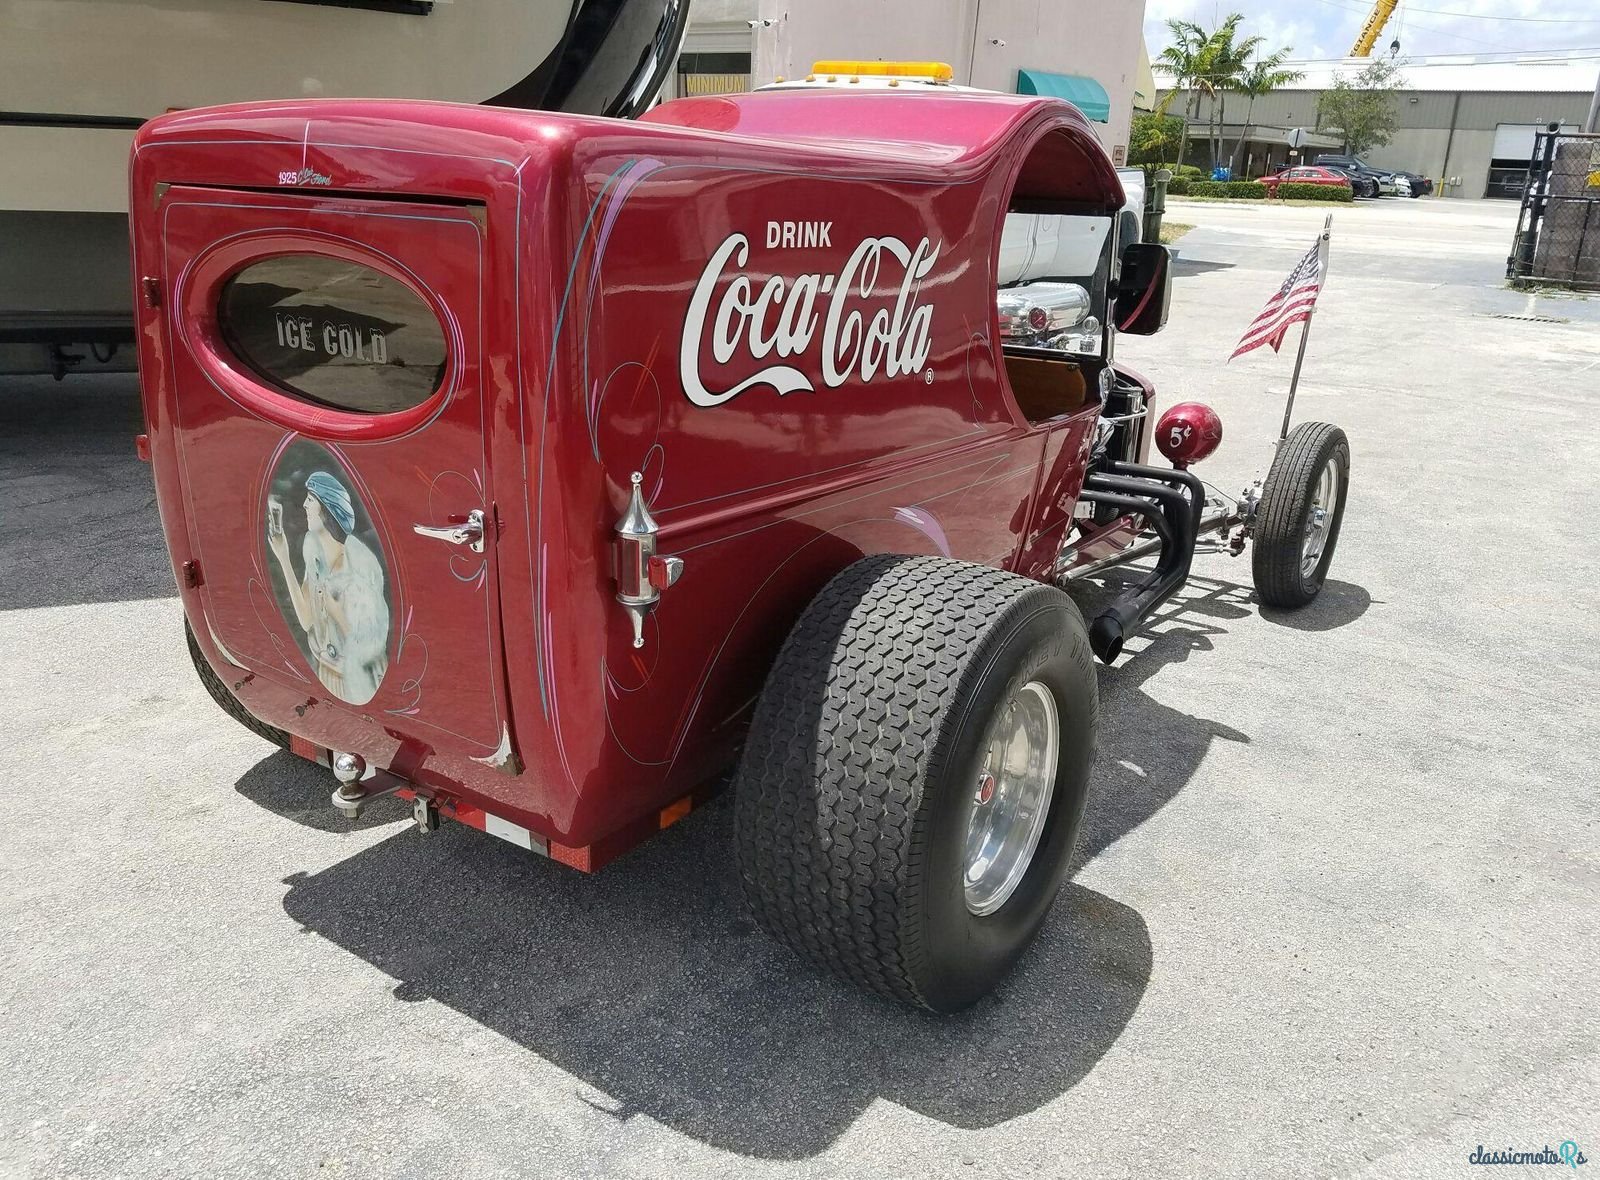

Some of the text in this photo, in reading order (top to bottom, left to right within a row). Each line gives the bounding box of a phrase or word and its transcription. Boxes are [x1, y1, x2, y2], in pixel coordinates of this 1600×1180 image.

[278, 171, 297, 185] 1925
[766, 221, 833, 249] DRINK
[276, 312, 387, 364] ICE COLD
[679, 232, 943, 408] Coca-Cola
